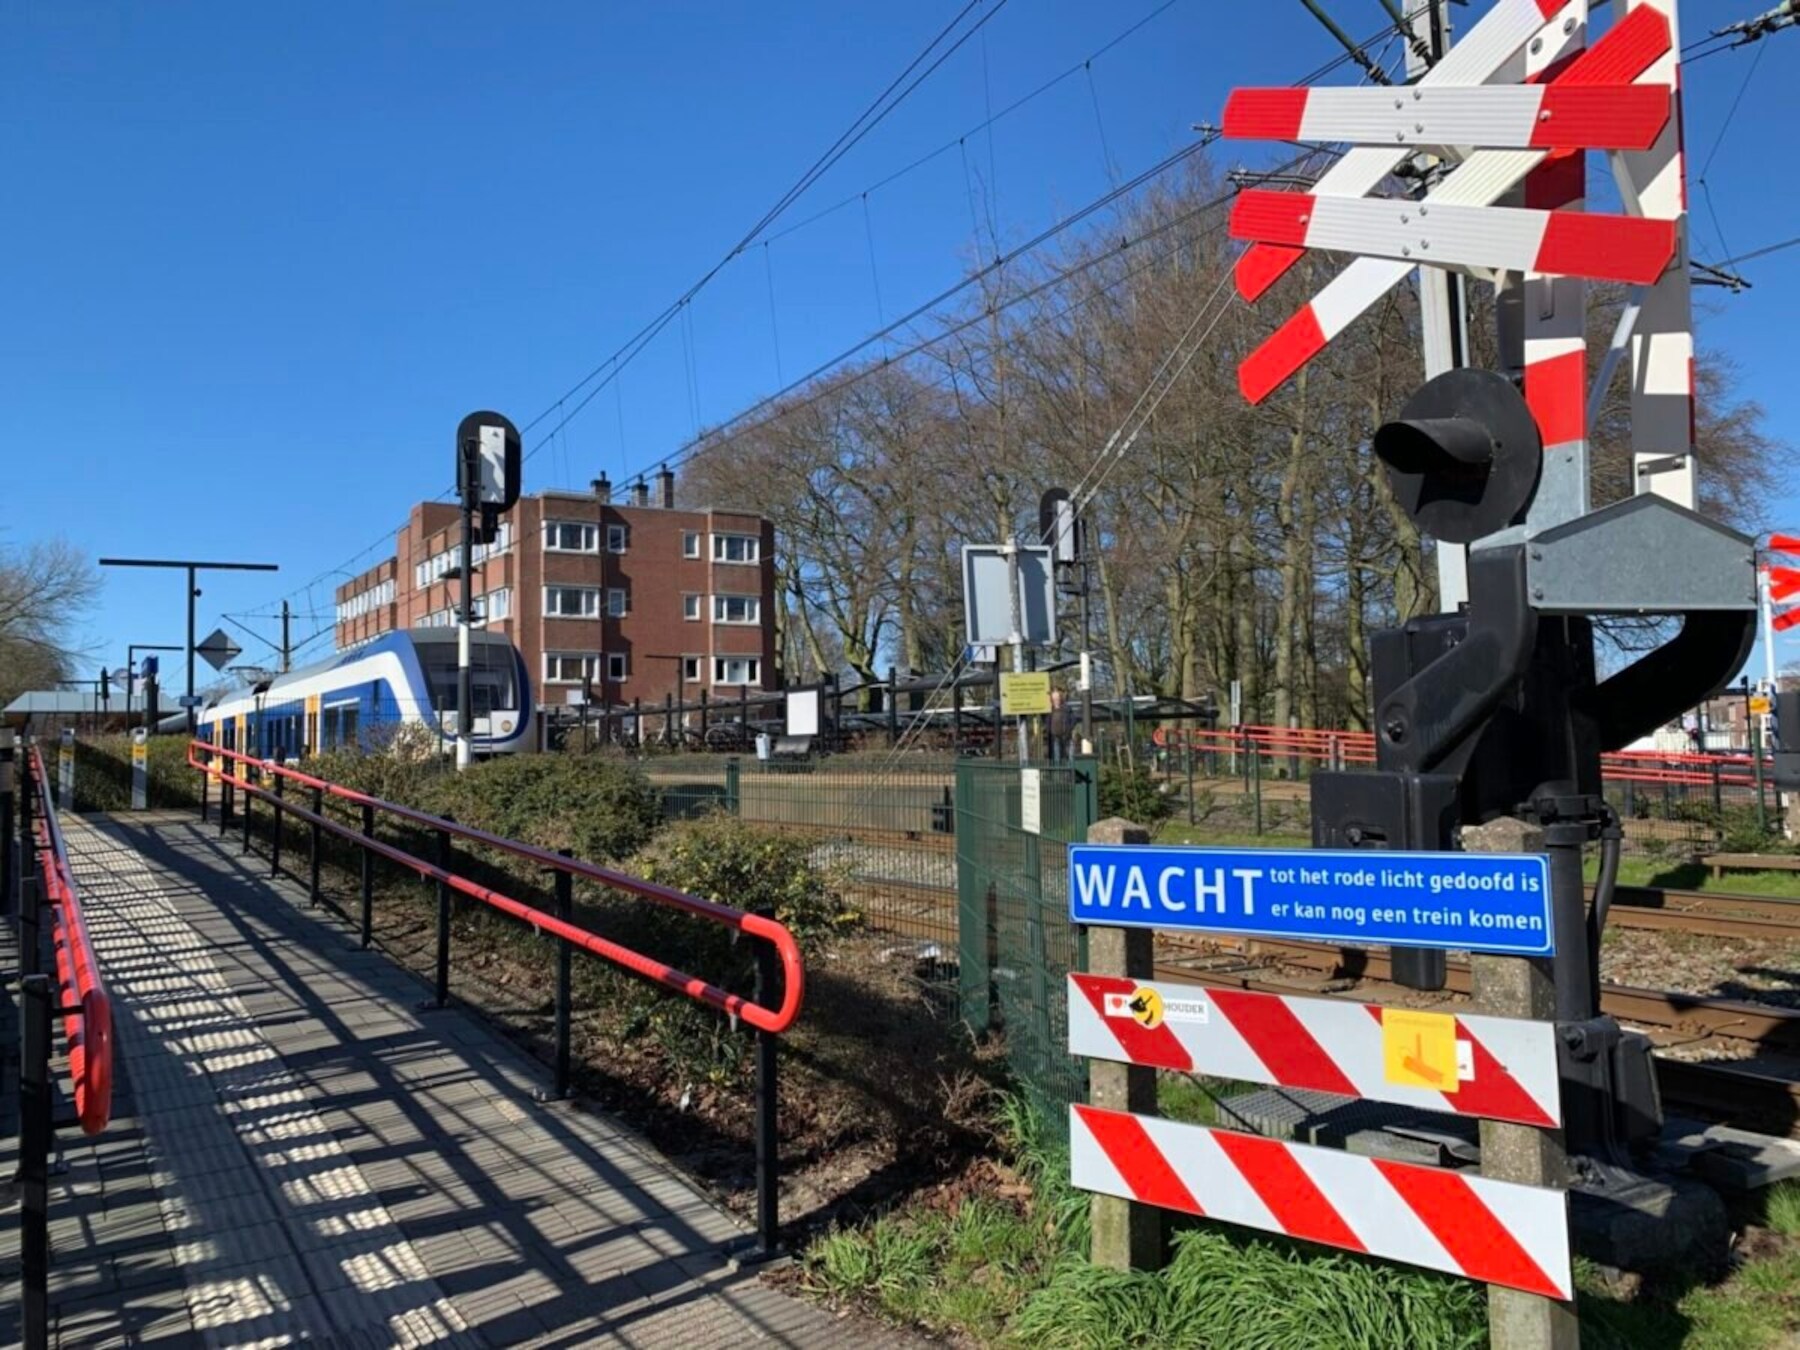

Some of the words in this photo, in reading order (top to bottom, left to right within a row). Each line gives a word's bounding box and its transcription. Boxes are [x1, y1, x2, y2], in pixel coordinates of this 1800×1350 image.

[1074, 863, 1263, 915] WACHT
[1271, 869, 1294, 883] tot
[1301, 869, 1328, 884] het
[1335, 871, 1375, 887] rode
[1381, 871, 1423, 887] licht
[1430, 872, 1514, 894] gedoofd
[1522, 873, 1540, 893] is
[1271, 904, 1289, 917] er
[1295, 902, 1325, 919] kan
[1332, 907, 1366, 926] nog
[1372, 909, 1406, 923] een
[1413, 908, 1462, 926] trein
[1469, 910, 1543, 930] komen
